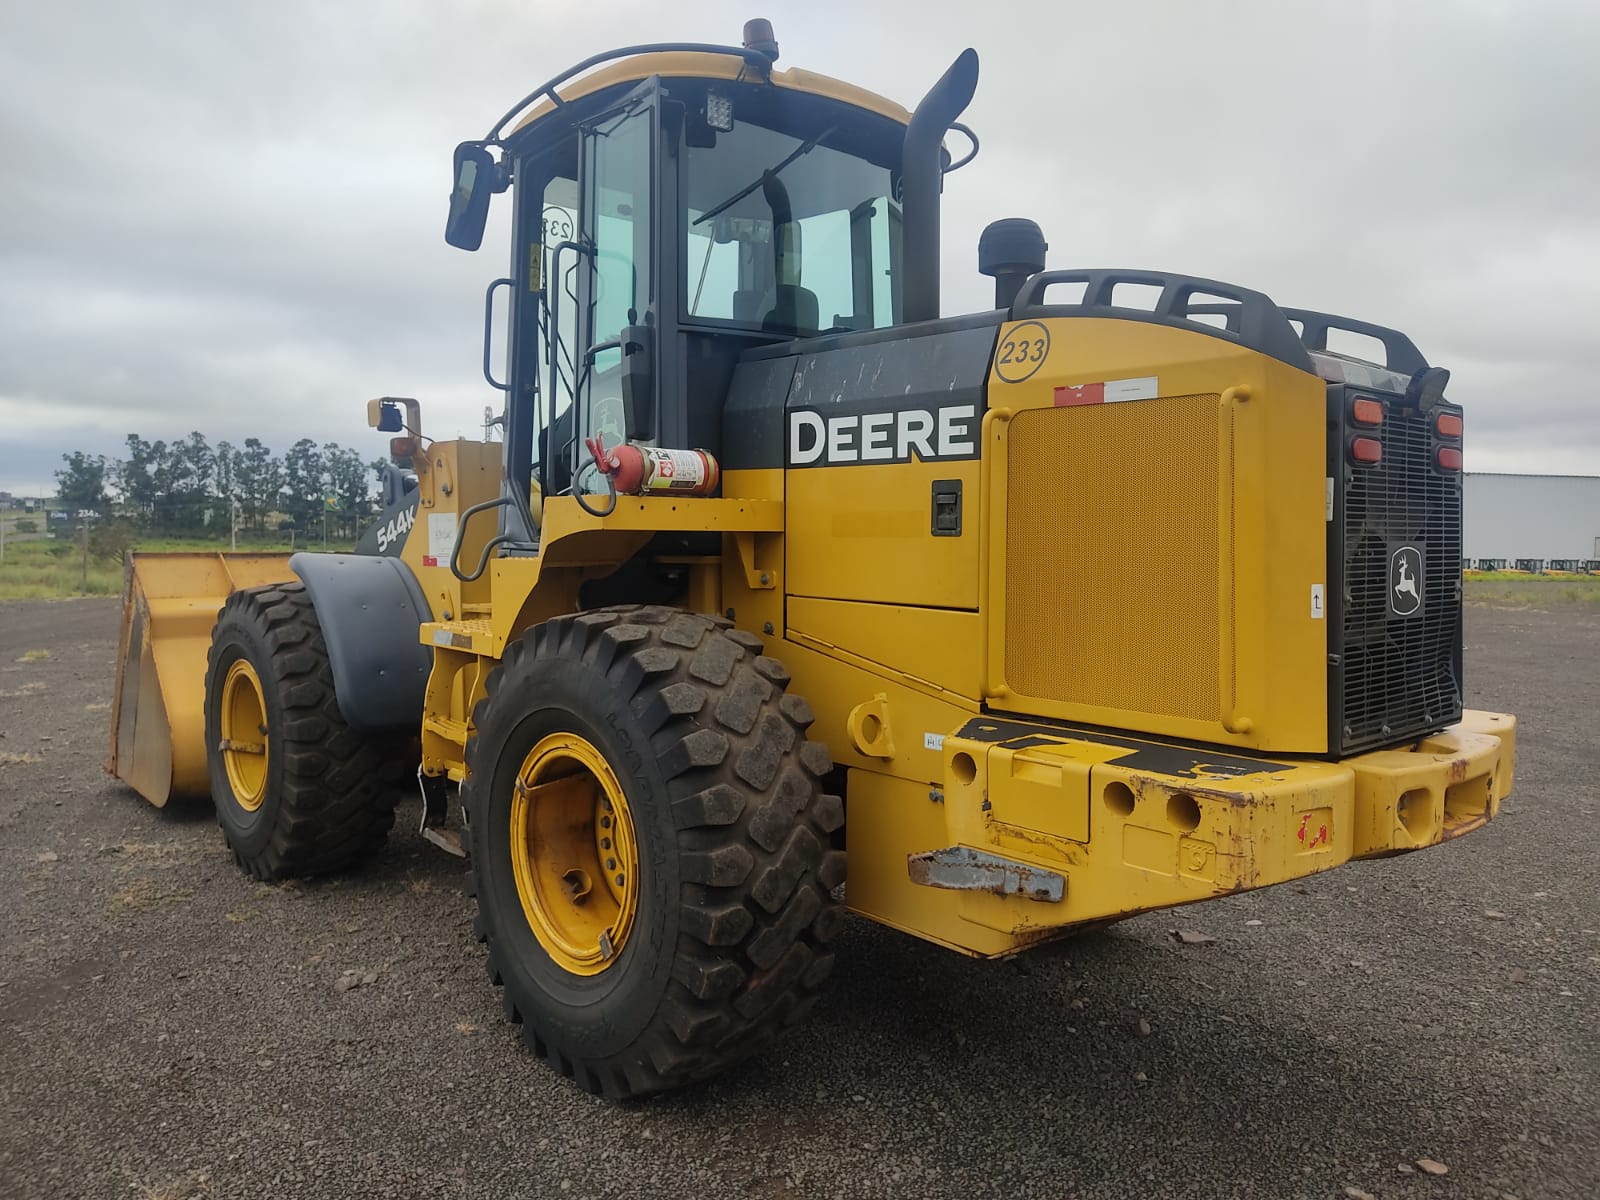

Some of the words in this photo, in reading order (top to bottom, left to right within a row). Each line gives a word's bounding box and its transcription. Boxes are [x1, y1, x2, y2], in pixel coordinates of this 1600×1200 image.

[1000, 338, 1045, 364] 233
[790, 405, 975, 464] DEERE
[376, 504, 415, 552] 544K
